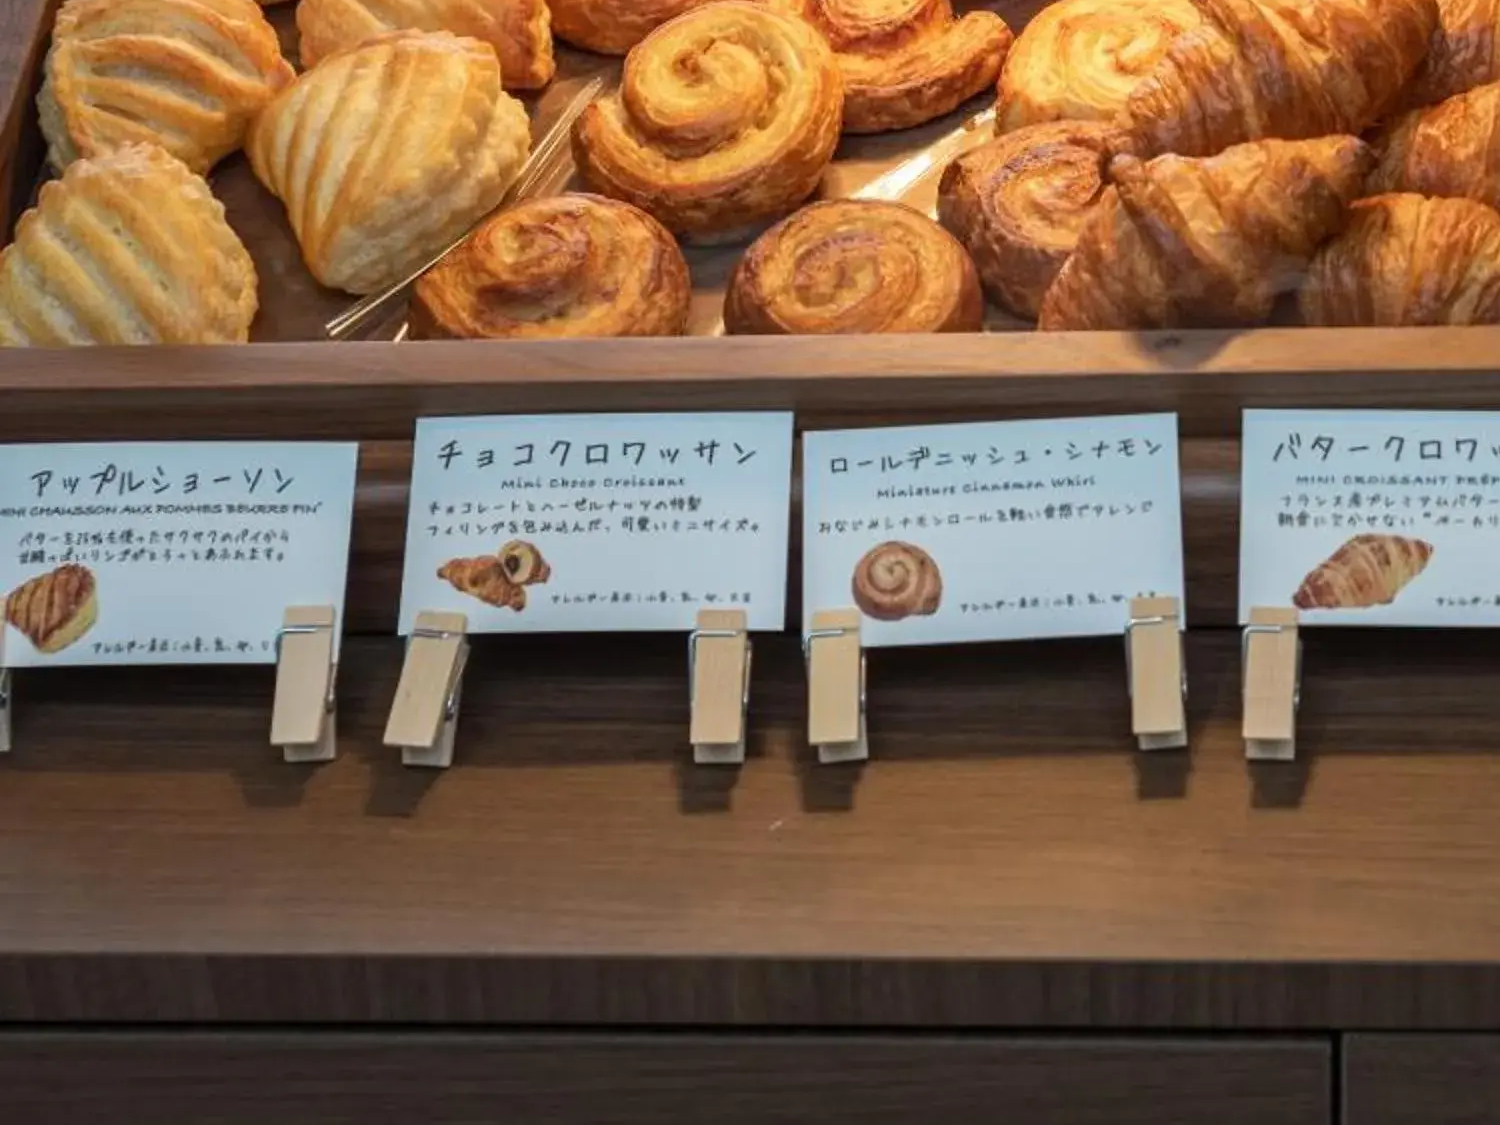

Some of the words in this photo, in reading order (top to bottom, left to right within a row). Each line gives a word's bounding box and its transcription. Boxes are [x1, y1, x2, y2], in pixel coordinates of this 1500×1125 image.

[437, 439, 757, 470] チョコクロワッサン
[831, 438, 1163, 473] ロールデニッシュ・シナモン
[31, 465, 296, 498] アップルショーソン
[501, 477, 542, 490] Mini
[1296, 475, 1335, 485] MINI
